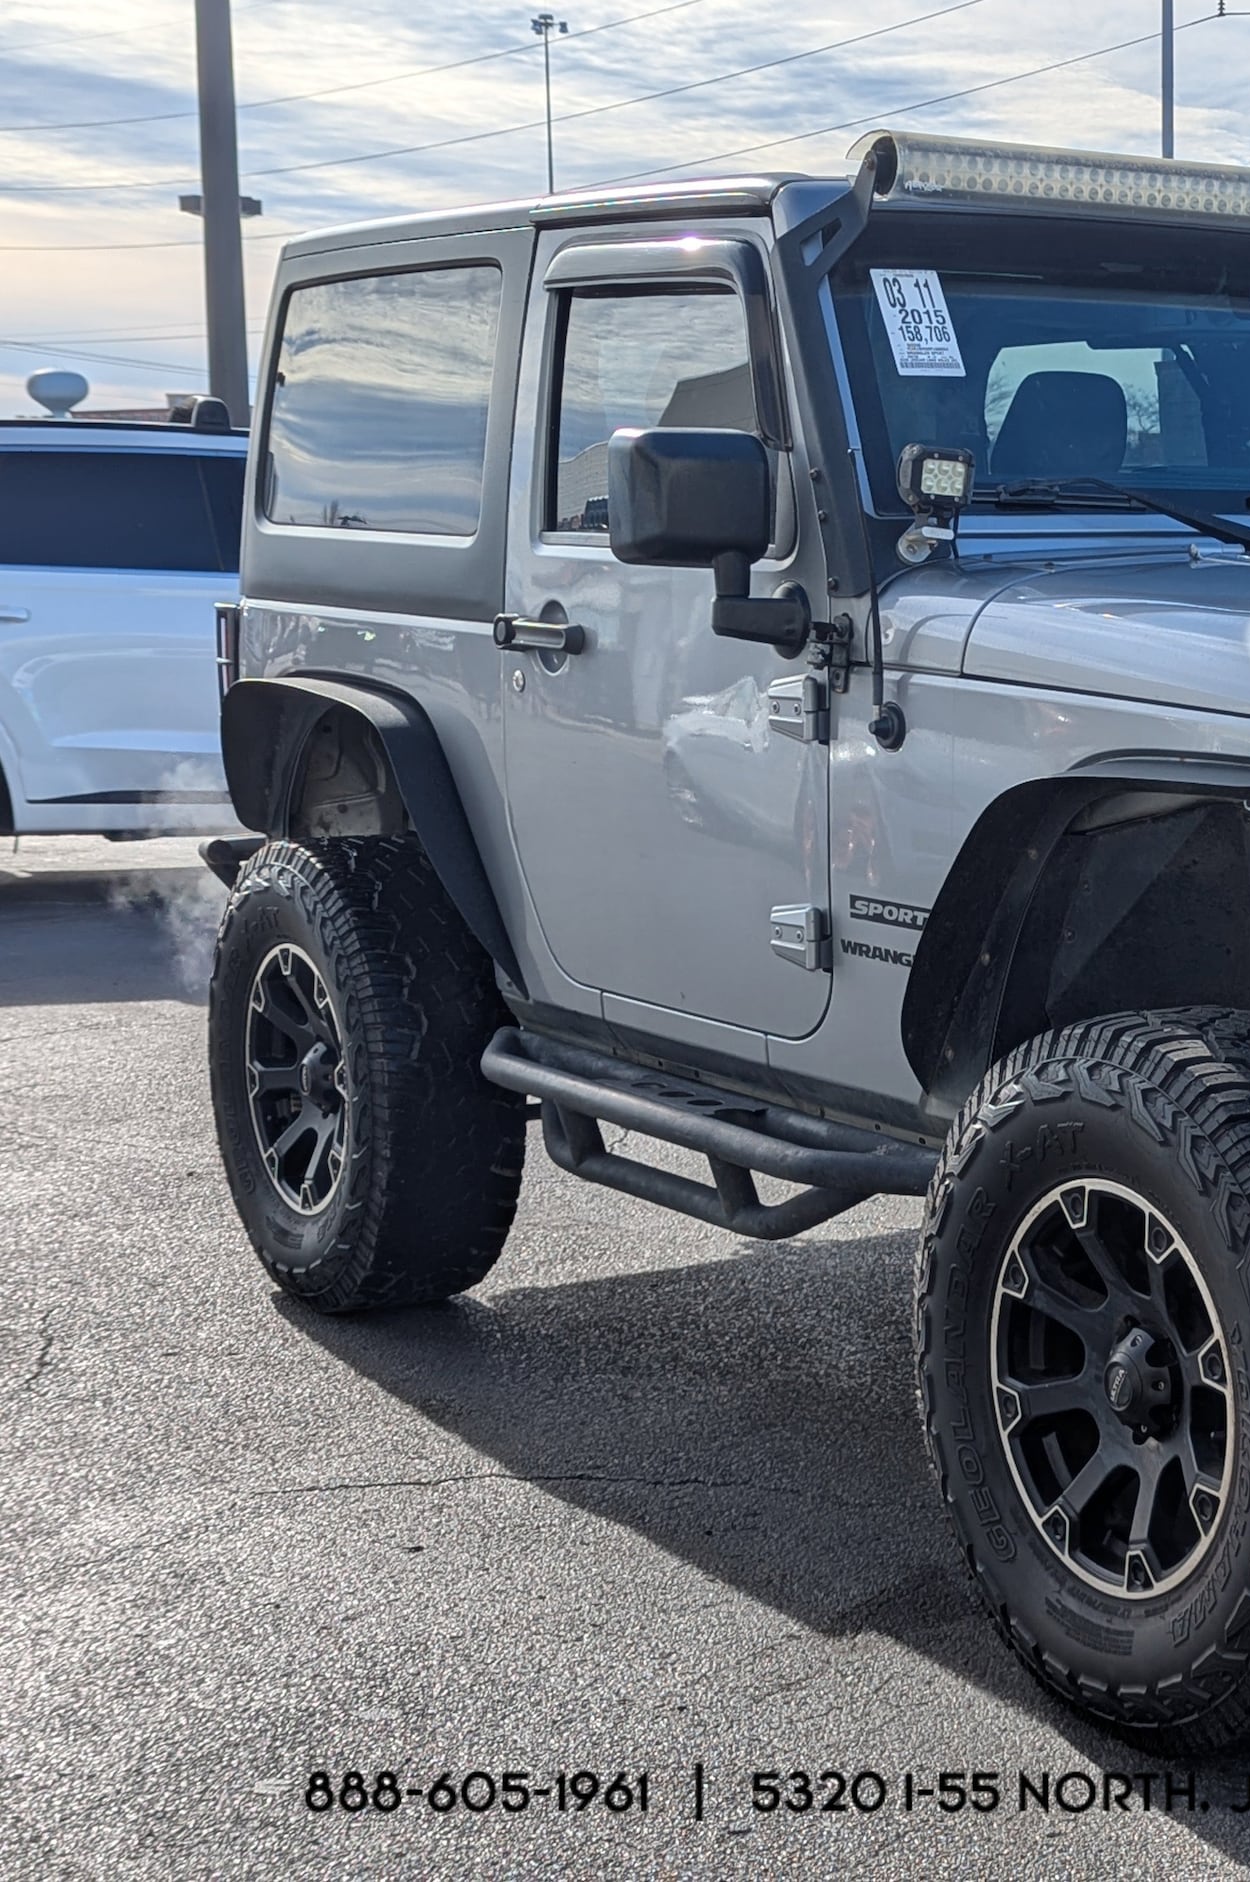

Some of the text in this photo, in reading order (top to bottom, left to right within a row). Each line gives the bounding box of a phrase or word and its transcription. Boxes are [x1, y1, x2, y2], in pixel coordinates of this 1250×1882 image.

[882, 277, 936, 309] 03 11
[898, 308, 946, 325] 2015
[898, 325, 951, 344] 158,706
[853, 899, 931, 926] SPORT
[840, 938, 915, 968] WRANG
